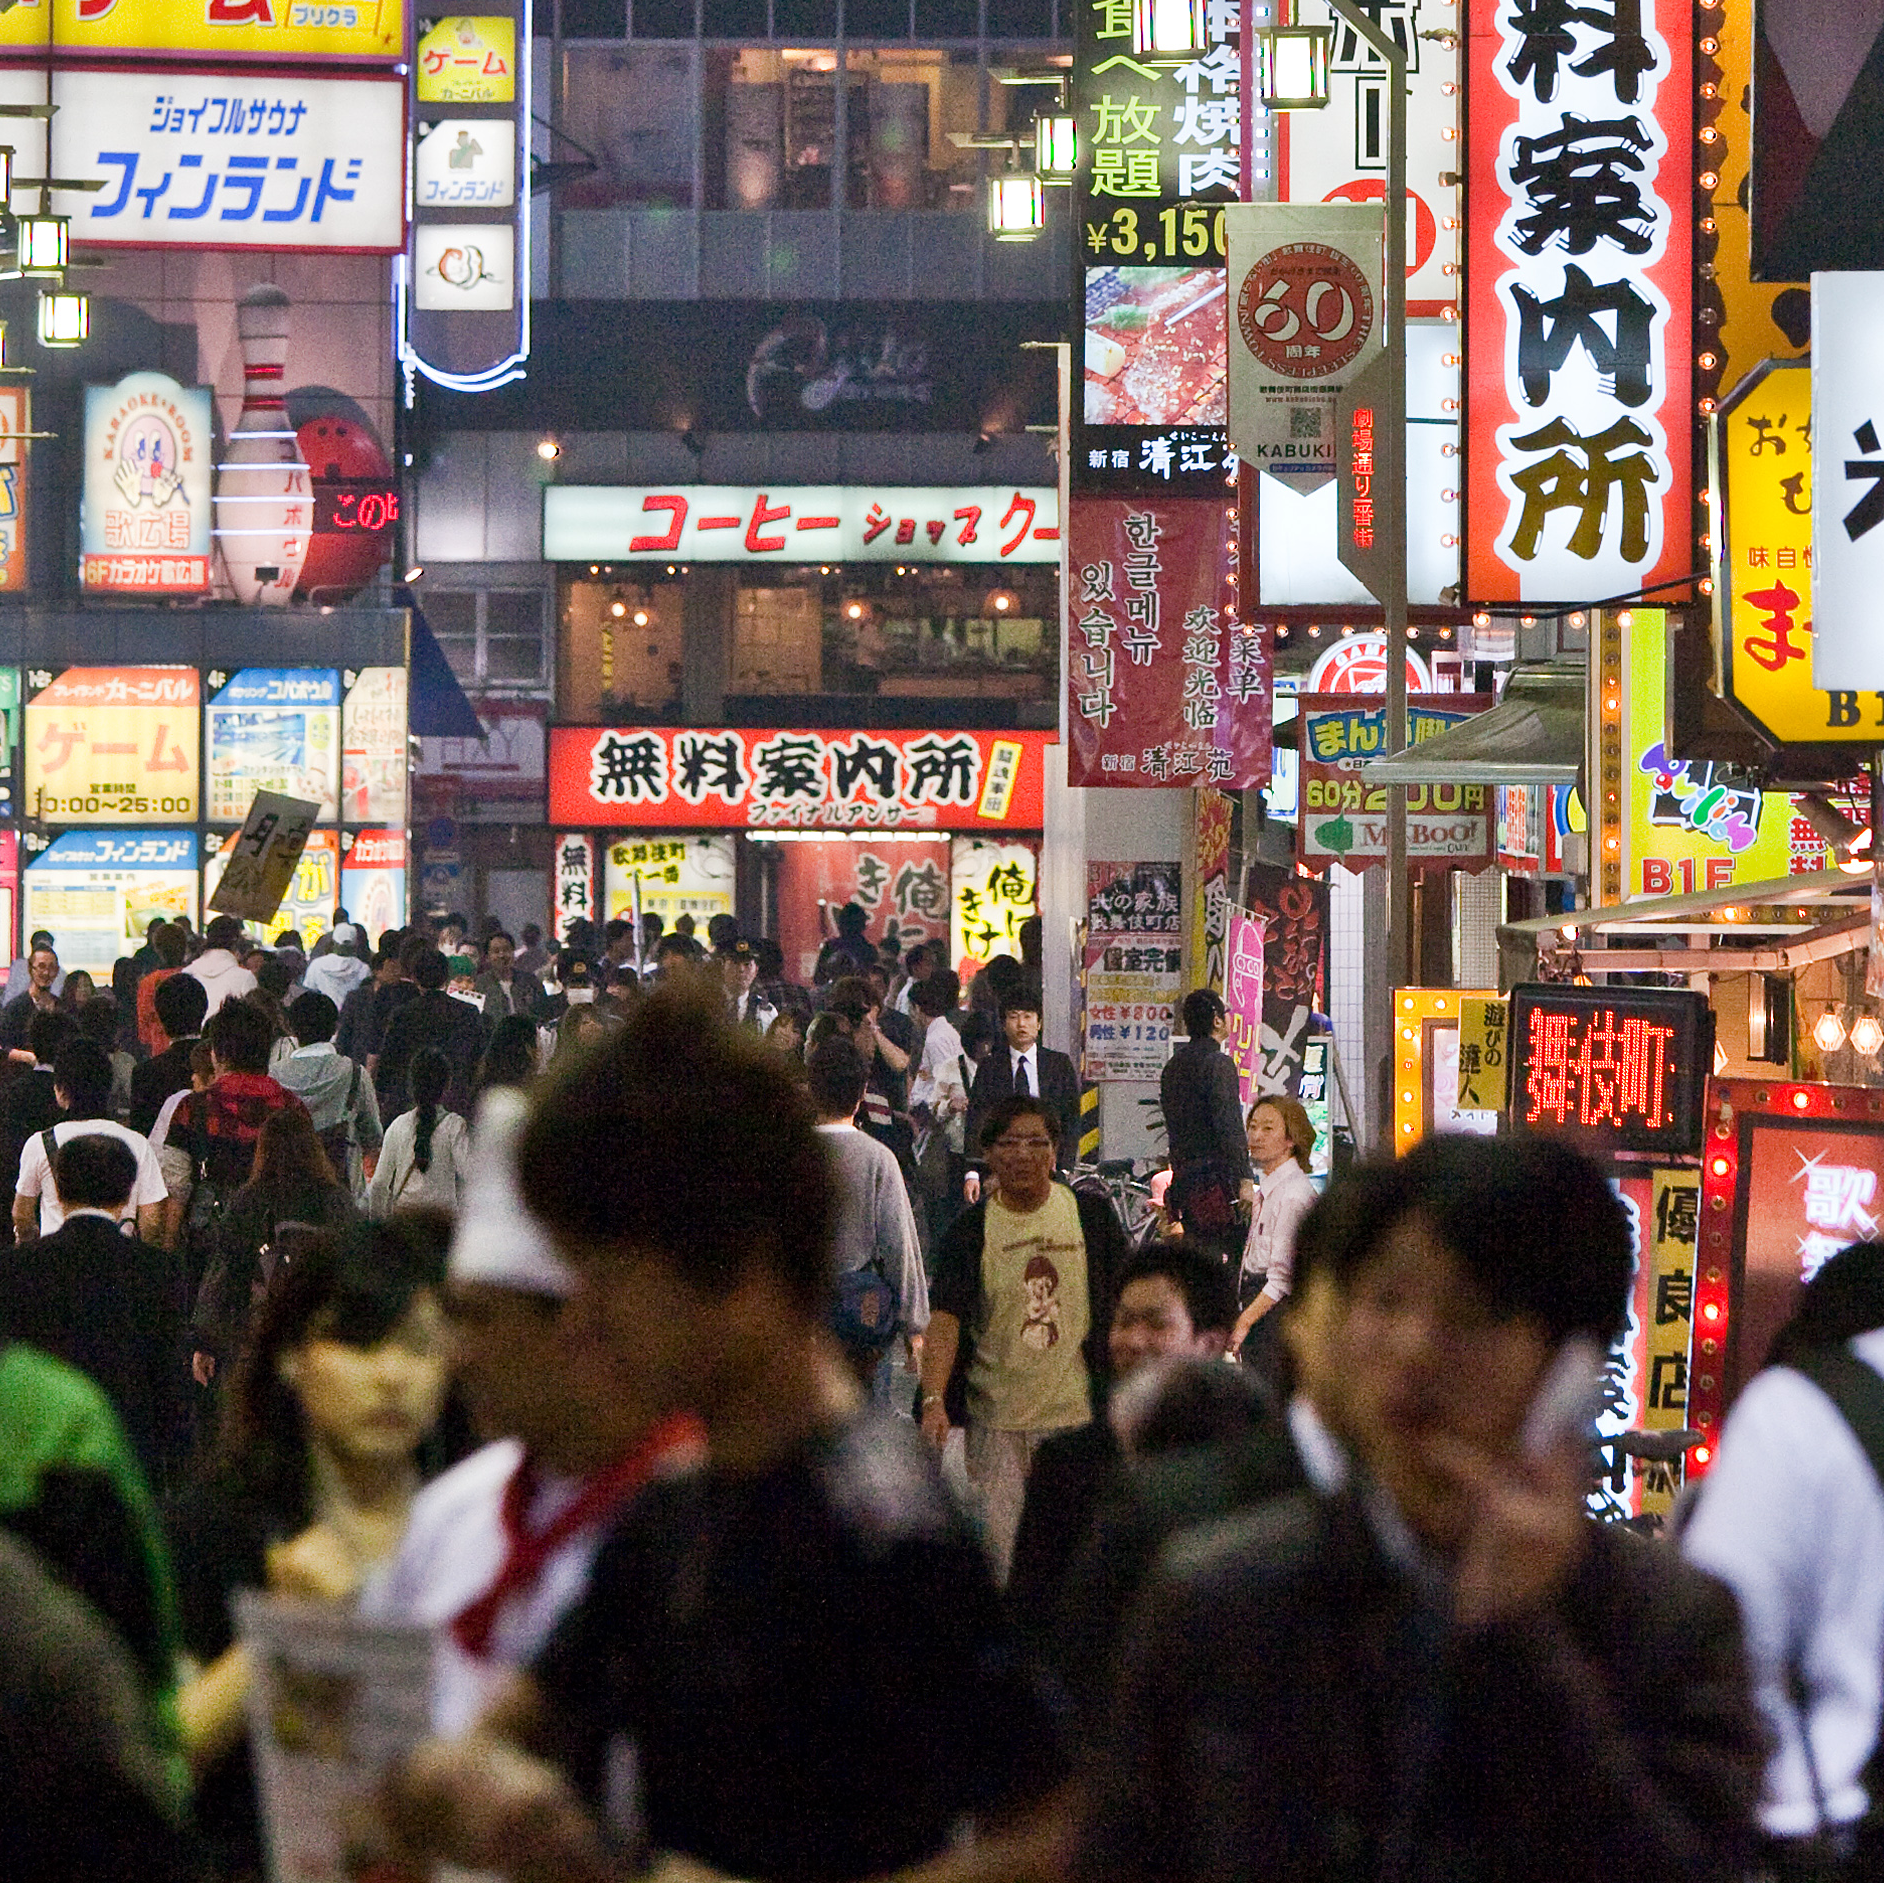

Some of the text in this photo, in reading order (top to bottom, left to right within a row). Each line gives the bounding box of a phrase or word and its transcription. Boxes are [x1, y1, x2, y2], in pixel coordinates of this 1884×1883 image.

[294, 5, 358, 27] プリクラ
[422, 49, 508, 77] ゲーム
[149, 95, 308, 137] ジョイフルサウナ
[91, 152, 364, 224] フィンランド
[425, 180, 506, 201] フィンランド
[1253, 275, 1355, 342] 60
[1087, 447, 1129, 469] 新宿
[628, 494, 982, 554] コーヒーショップ
[1123, 513, 1163, 667] 한글메뉴
[1077, 560, 1116, 729] 있습니다
[1183, 604, 1219, 730] 欢迎光临
[103, 677, 195, 702] カーニバル
[36, 722, 191, 775] ゲーム
[590, 731, 982, 806] 無料案内所
[748, 803, 922, 825] ファイナルアンサー
[95, 839, 192, 863] フィンランド
[1641, 857, 1736, 894] B1F
